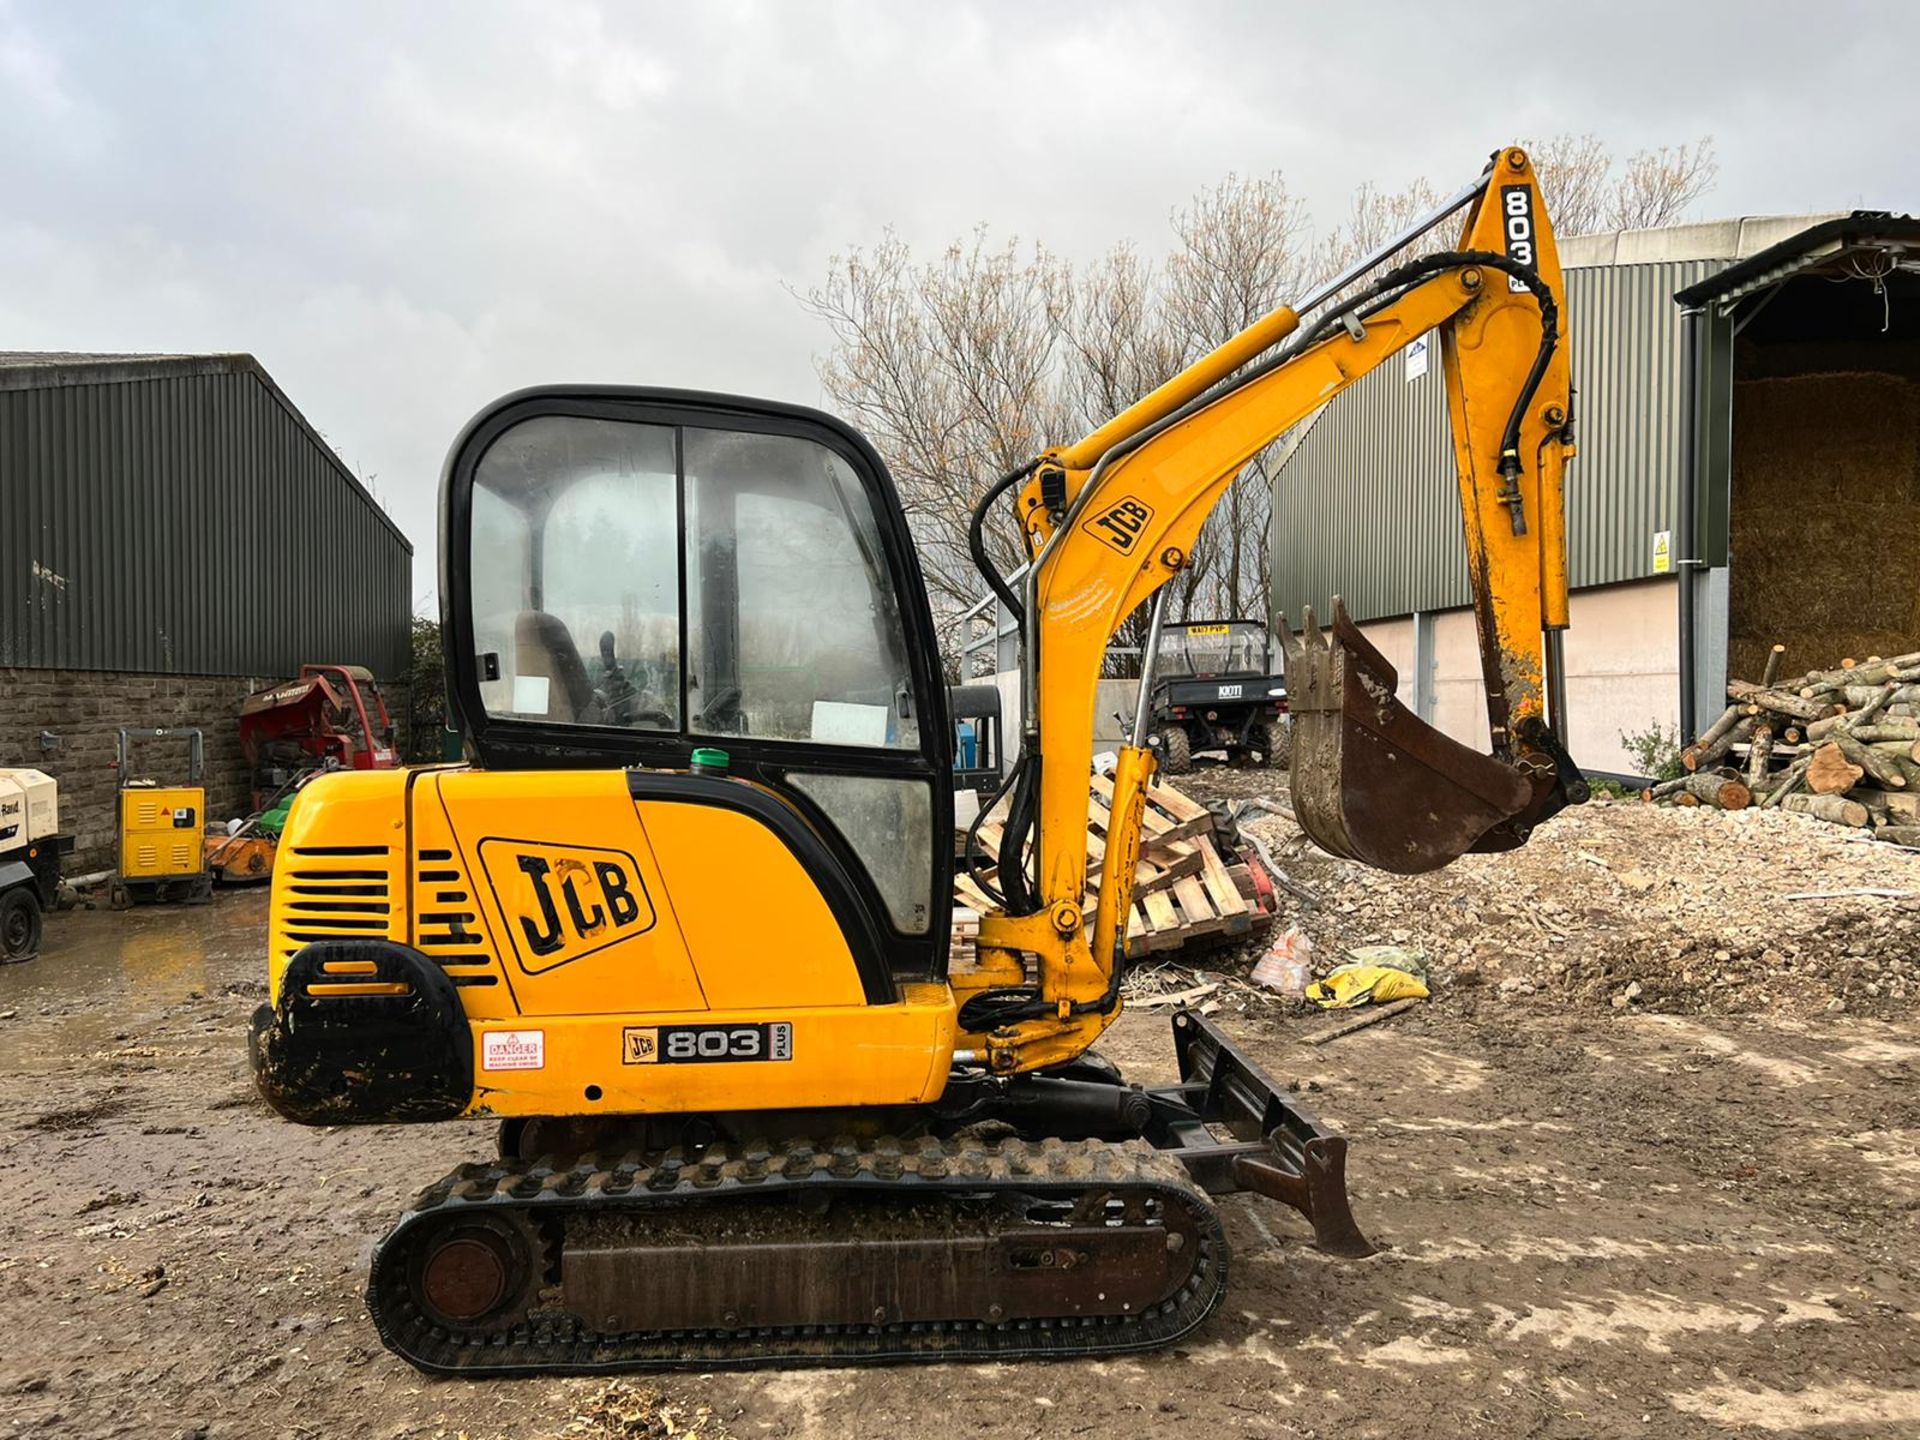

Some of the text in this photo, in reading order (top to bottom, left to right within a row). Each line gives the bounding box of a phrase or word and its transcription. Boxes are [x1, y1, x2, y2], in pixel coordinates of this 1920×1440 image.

[1506, 191, 1532, 266] 803
[1096, 501, 1148, 549] JCB
[1218, 685, 1243, 697] KIOTI
[516, 854, 640, 957] JCB
[490, 1044, 537, 1055] DANGER
[632, 1025, 787, 1058] JCB 803 PLUS
